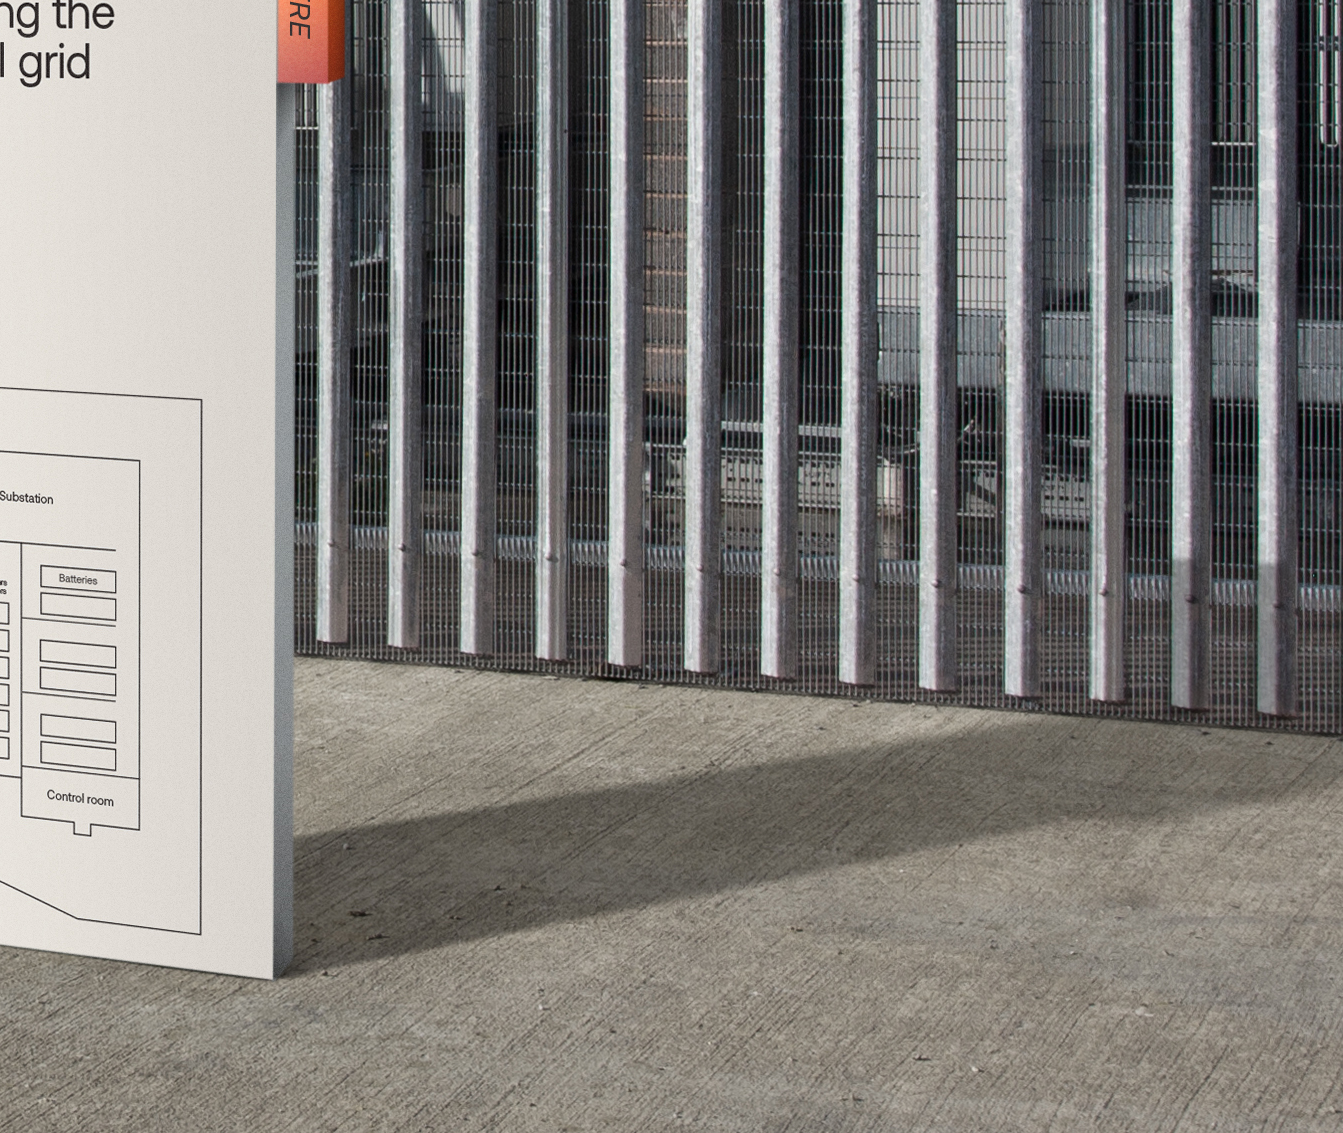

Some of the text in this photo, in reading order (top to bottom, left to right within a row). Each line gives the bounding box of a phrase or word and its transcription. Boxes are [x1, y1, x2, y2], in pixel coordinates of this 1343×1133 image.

[18, 42, 90, 87] grid
[0, 490, 54, 505] Substation
[59, 573, 98, 586] Batteries
[47, 789, 114, 807] Control room
